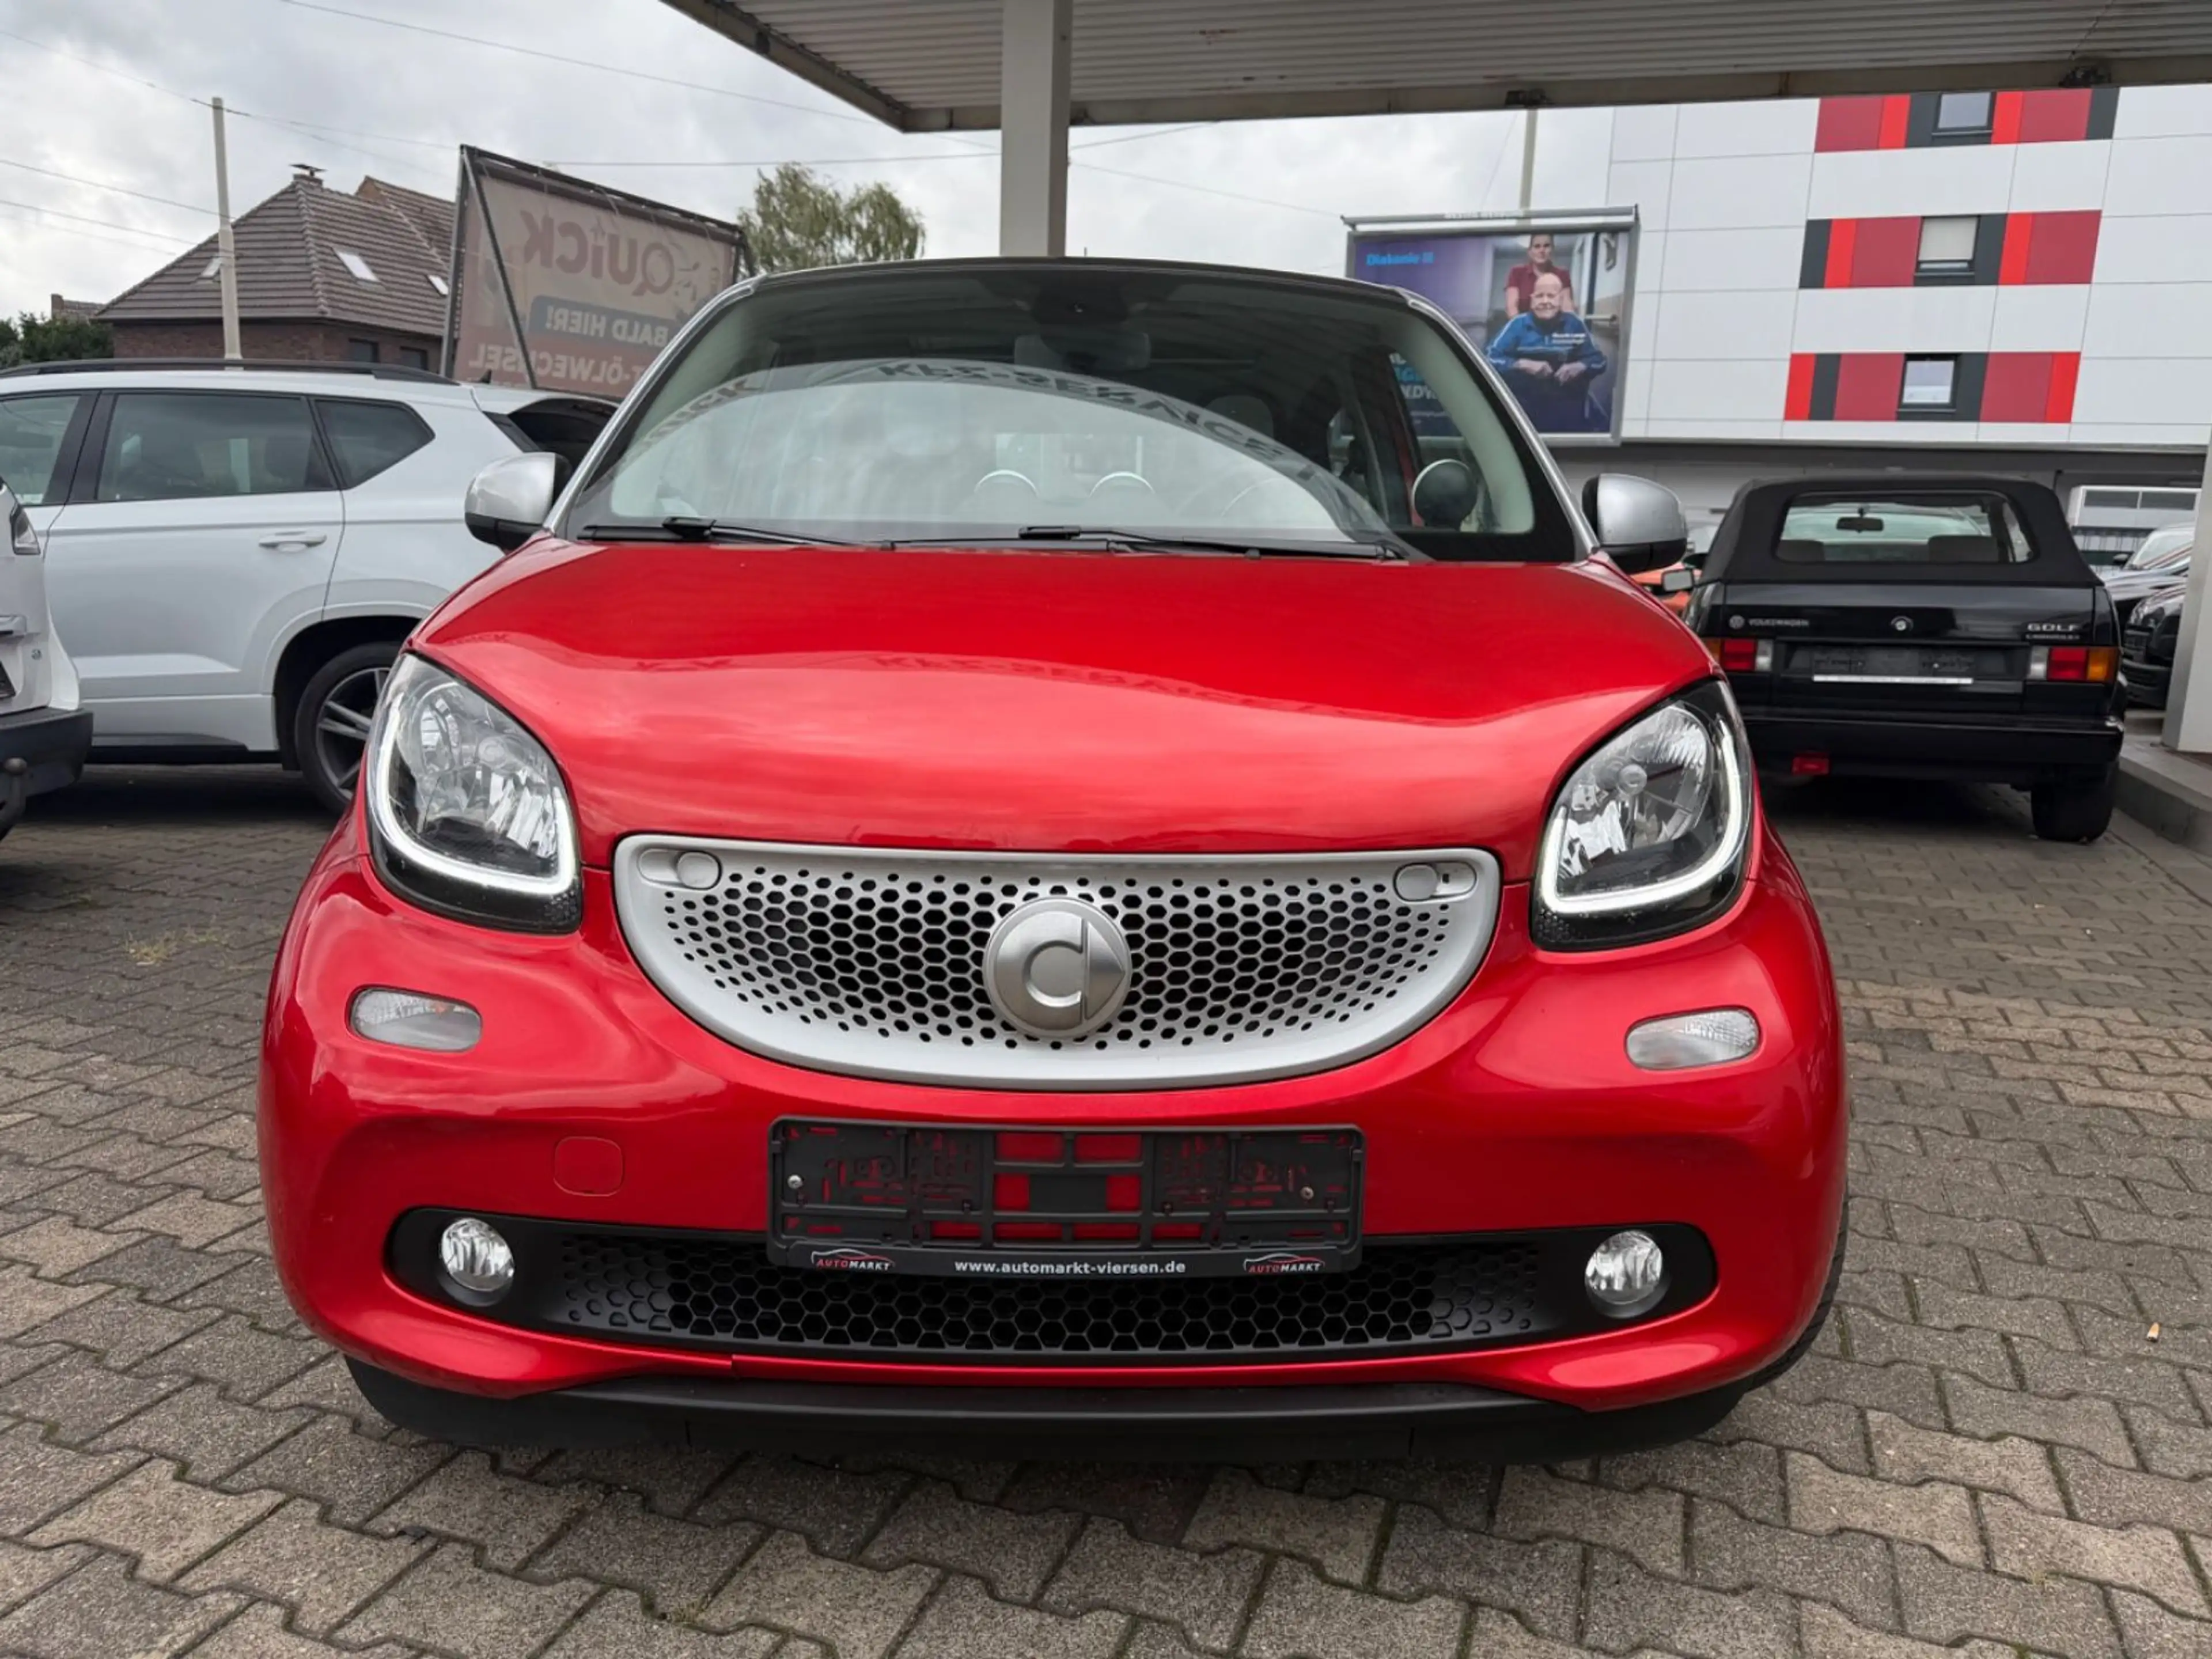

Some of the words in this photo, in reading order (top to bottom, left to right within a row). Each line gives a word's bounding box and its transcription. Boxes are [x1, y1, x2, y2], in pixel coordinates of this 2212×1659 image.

[2028, 623, 2079, 631] GOLF
[817, 1259, 889, 1271] AUTOMARKT
[955, 1260, 1187, 1274] www.automarkt-viersen.de
[1249, 1263, 1321, 1273] AUTOMARKT
